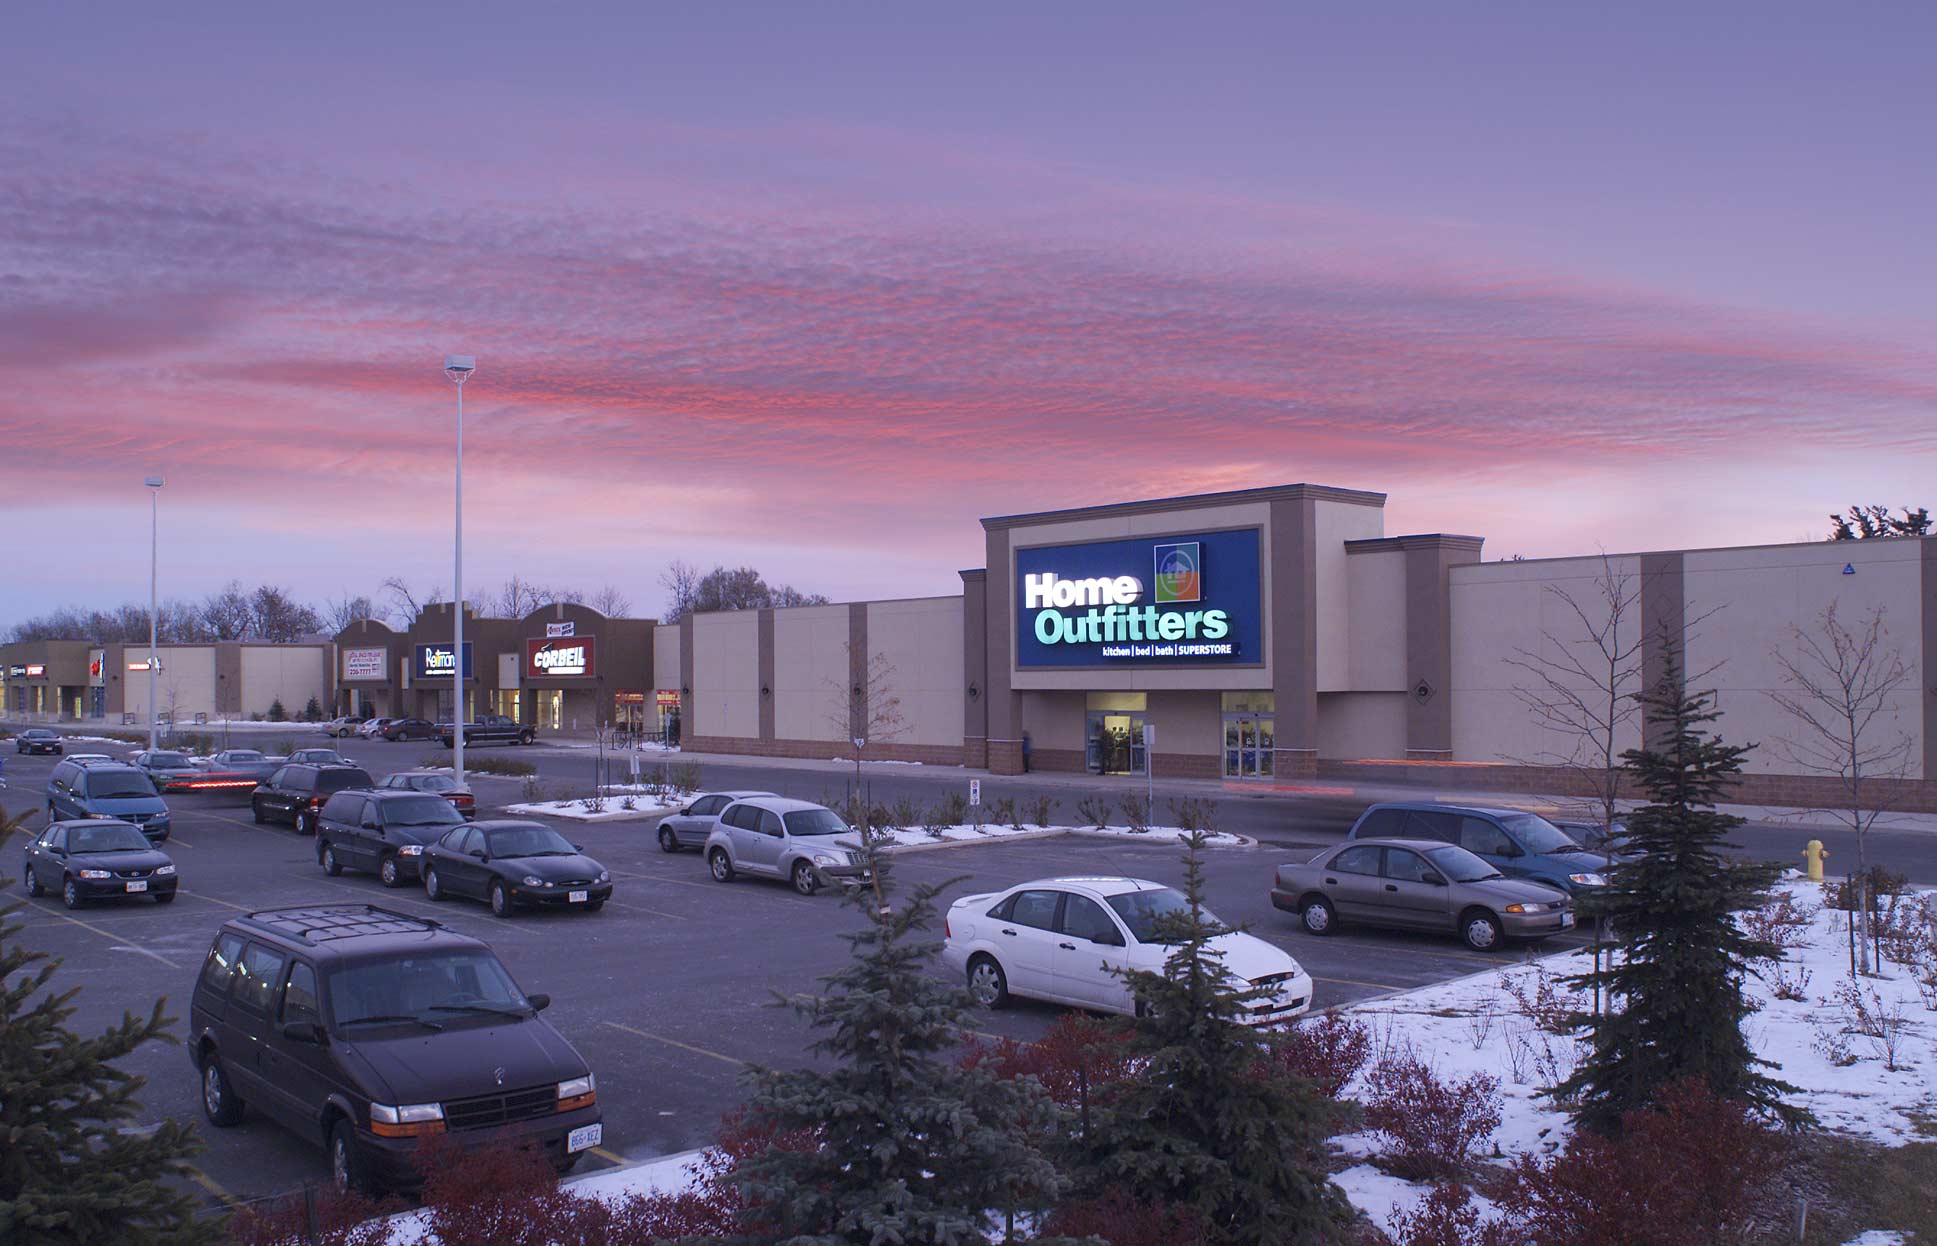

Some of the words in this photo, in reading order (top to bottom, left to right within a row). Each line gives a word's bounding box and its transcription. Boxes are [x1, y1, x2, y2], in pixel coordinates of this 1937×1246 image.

[1025, 572, 1142, 608] Home
[1034, 604, 1229, 645] Outfitters
[534, 646, 586, 668] CORBEIL
[1102, 646, 1130, 657] kitchen
[1136, 646, 1150, 656] bed
[1155, 646, 1173, 656] bath
[1178, 645, 1232, 655] SUPERSTORE
